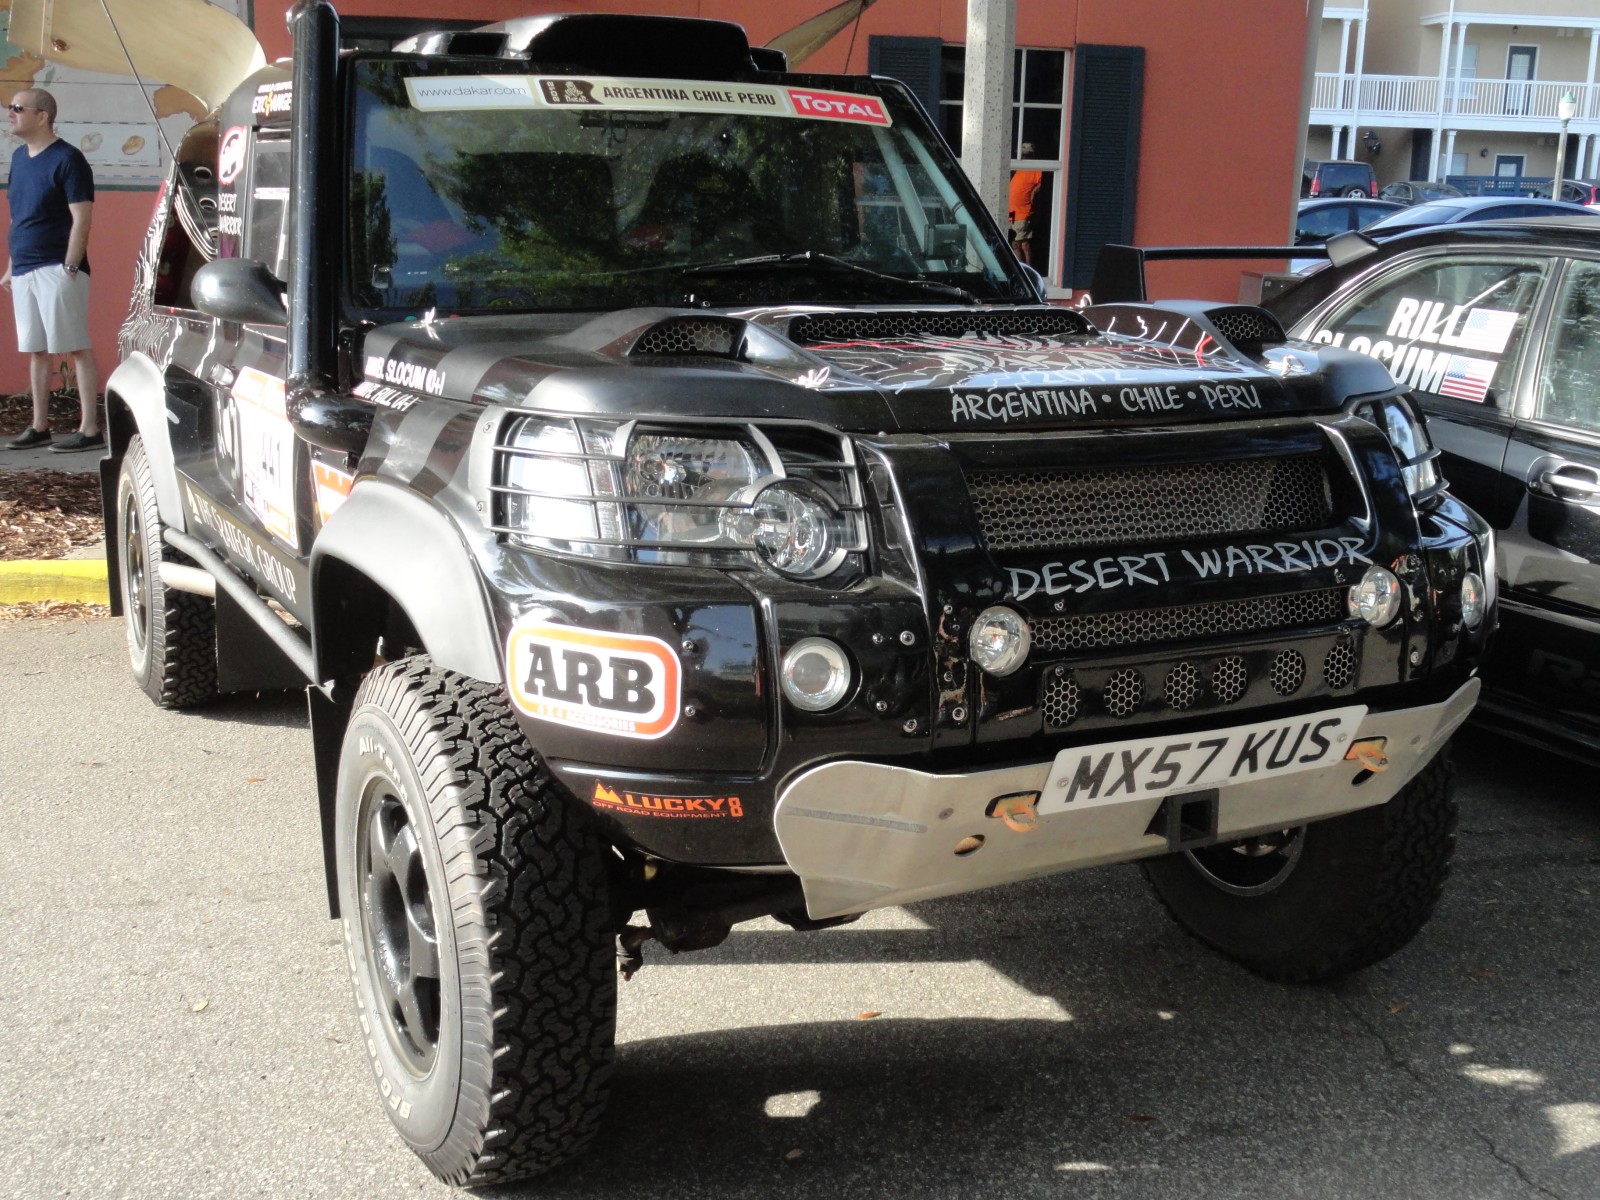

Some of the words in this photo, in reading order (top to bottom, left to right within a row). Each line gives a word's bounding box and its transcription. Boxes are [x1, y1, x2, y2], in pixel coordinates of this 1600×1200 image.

[417, 85, 527, 97] www.dakar.com
[603, 86, 688, 101] ARGENTINA
[693, 90, 735, 103] CHILE
[737, 92, 776, 106] PERU
[792, 94, 883, 119] TOTAL
[218, 193, 237, 212] DESERT
[1386, 297, 1464, 347] RILL
[385, 359, 427, 391] SLOCUM
[952, 388, 1097, 423] ARGENTINA
[1120, 385, 1184, 412] CHILE
[1200, 383, 1262, 411] PERU
[256, 545, 297, 604] GROUP
[1002, 552, 1170, 600] DESERT
[1181, 537, 1374, 578] WARRIOR
[524, 642, 656, 714] ARB
[566, 710, 637, 733] ACCESSORIES
[1064, 737, 1230, 803] MX57
[1229, 717, 1342, 777] KUS
[592, 801, 613, 810] OFF
[616, 805, 649, 816] ROAD
[653, 810, 728, 819] EQUIPMENT
[625, 793, 727, 811] LUCKY
